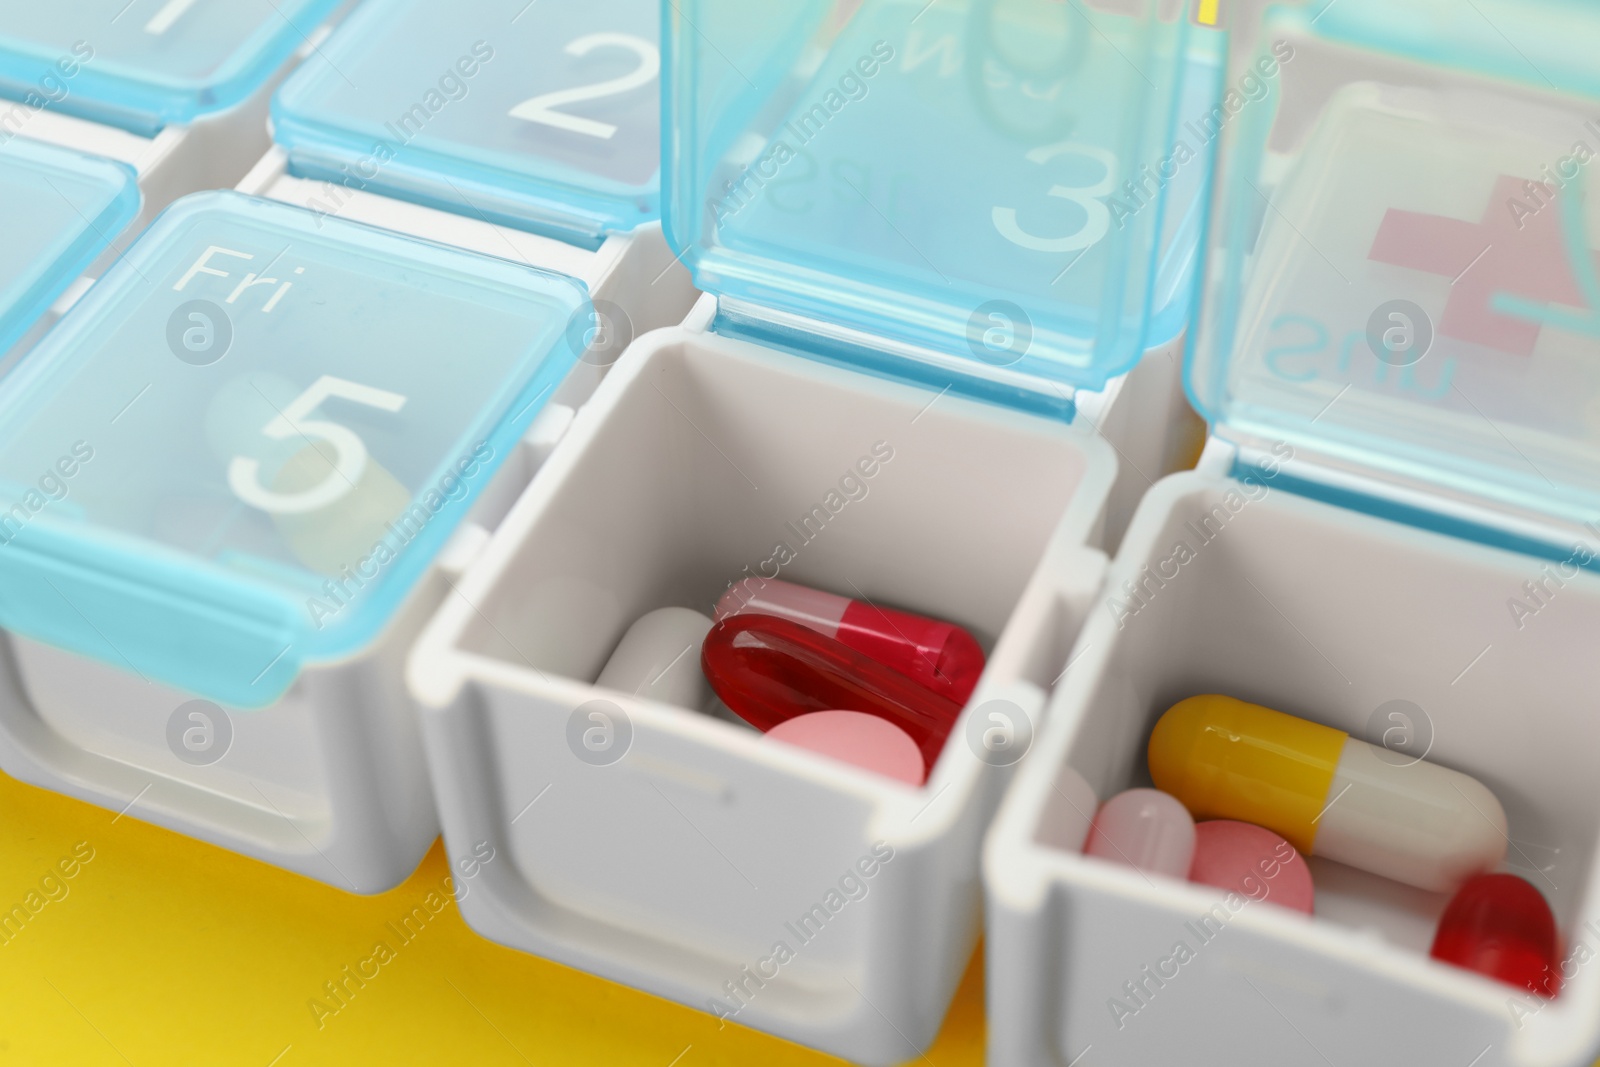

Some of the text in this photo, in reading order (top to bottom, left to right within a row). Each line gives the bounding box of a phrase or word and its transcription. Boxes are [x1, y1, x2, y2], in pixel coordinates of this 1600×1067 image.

[511, 32, 660, 140] 2
[992, 142, 1118, 253] 3
[173, 245, 305, 313] Fri
[228, 374, 407, 514] 5
